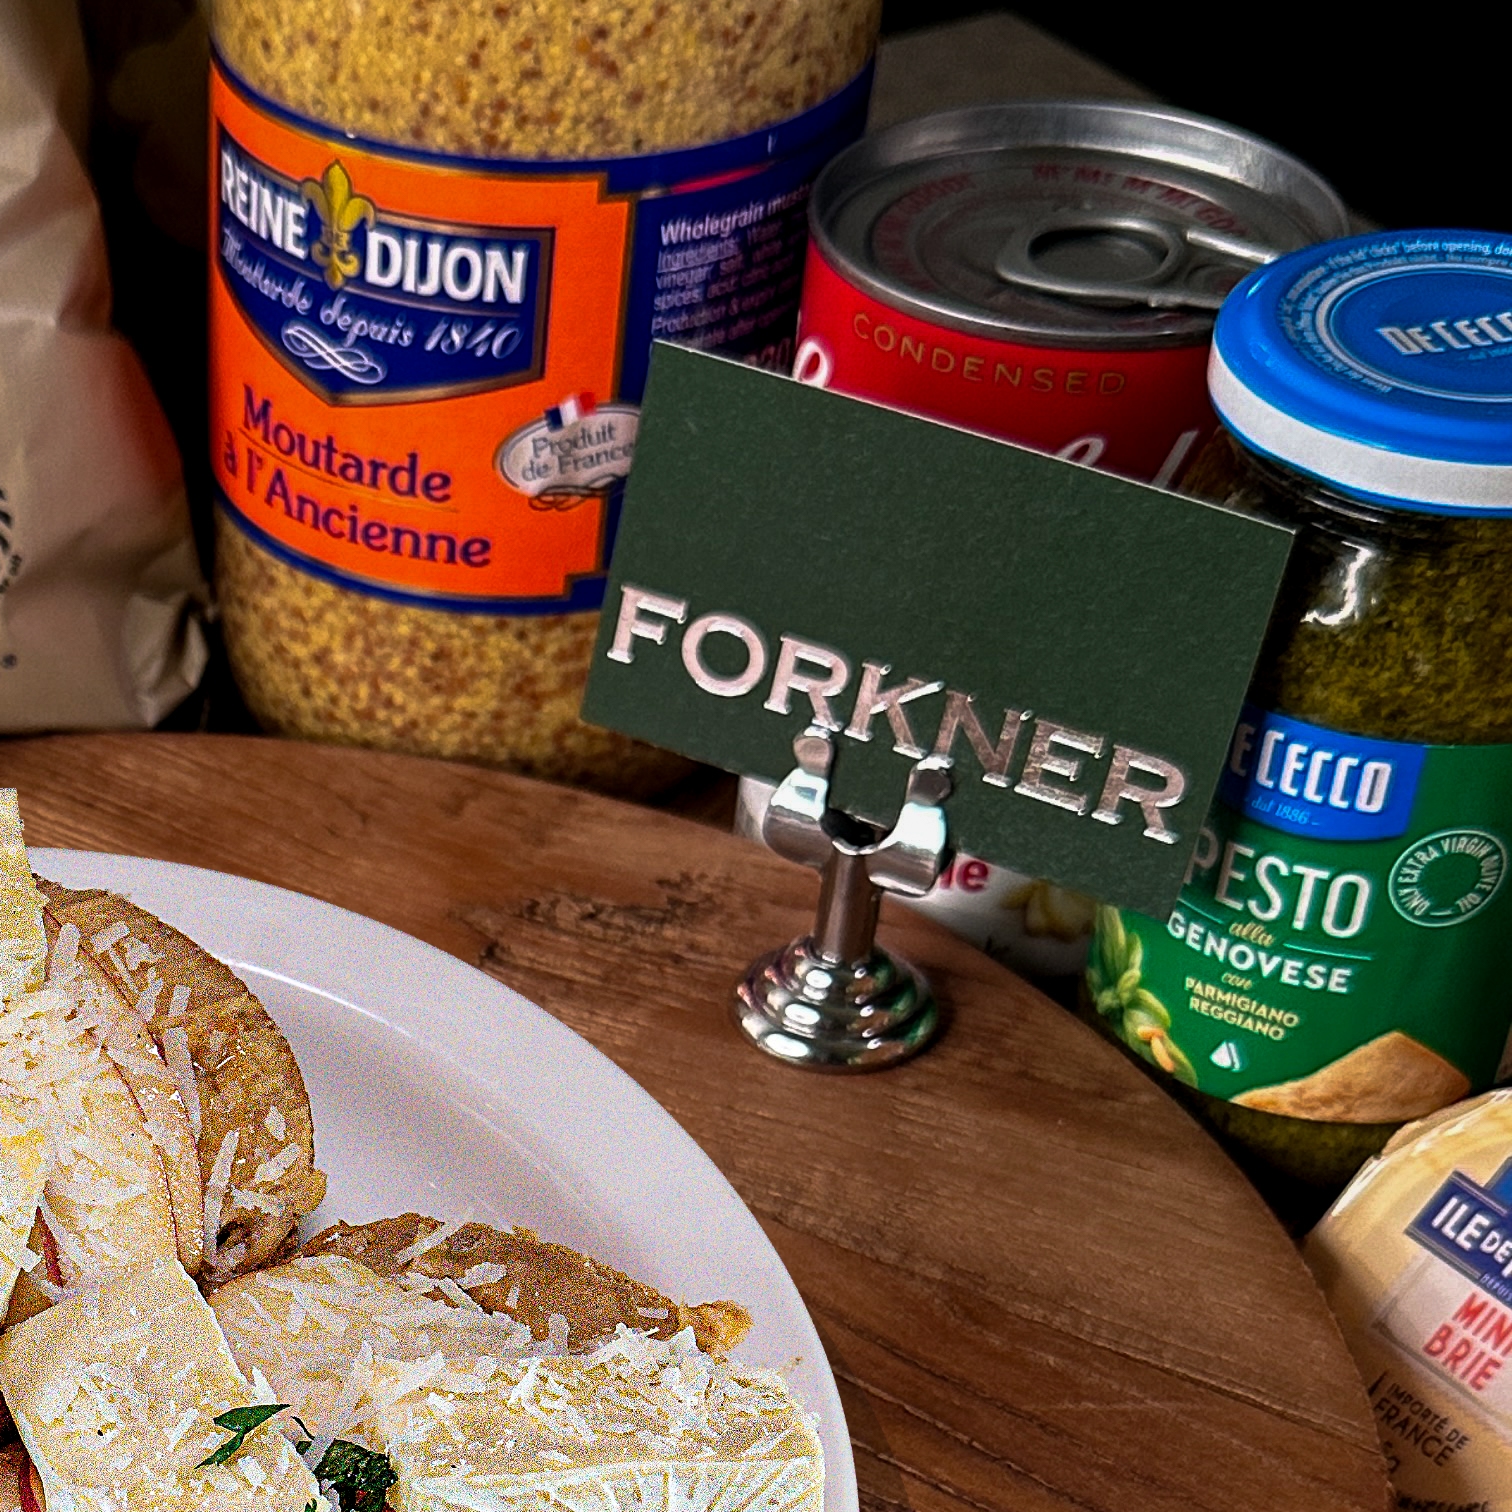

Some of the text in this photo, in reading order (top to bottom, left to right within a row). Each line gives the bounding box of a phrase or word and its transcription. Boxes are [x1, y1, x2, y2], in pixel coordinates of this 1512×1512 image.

[221, 150, 526, 304] REINE DIJON
[660, 201, 764, 246] Wholegrain
[319, 294, 415, 349] depuis
[424, 316, 524, 359] 1840
[853, 312, 1126, 396] CONDENSED
[242, 384, 451, 503] Moutarde
[532, 422, 616, 458] Produit
[224, 431, 493, 568] à l'Ancienne
[521, 460, 550, 482] de
[605, 582, 1186, 845] FORKNER
[1255, 728, 1392, 814] CECCO
[1251, 794, 1311, 825] dal 1886
[1397, 844, 1441, 883] EXTRA
[1440, 836, 1495, 859] VIRGIN
[1183, 826, 1371, 939] PESTO
[1454, 892, 1483, 914] OIL
[1166, 911, 1353, 994] GENOVESE
[1228, 921, 1276, 948] alla
[1184, 975, 1300, 1029] PARMIGIANO
[1221, 971, 1254, 991] con
[1189, 996, 1285, 1041] REGGIANO
[1431, 1196, 1491, 1252] ILE
[1422, 1322, 1503, 1391] BRIE
[1372, 1397, 1456, 1467] FRANCE
[1386, 1382, 1450, 1433] IMPORTÉ
[1445, 1428, 1471, 1451] DE
